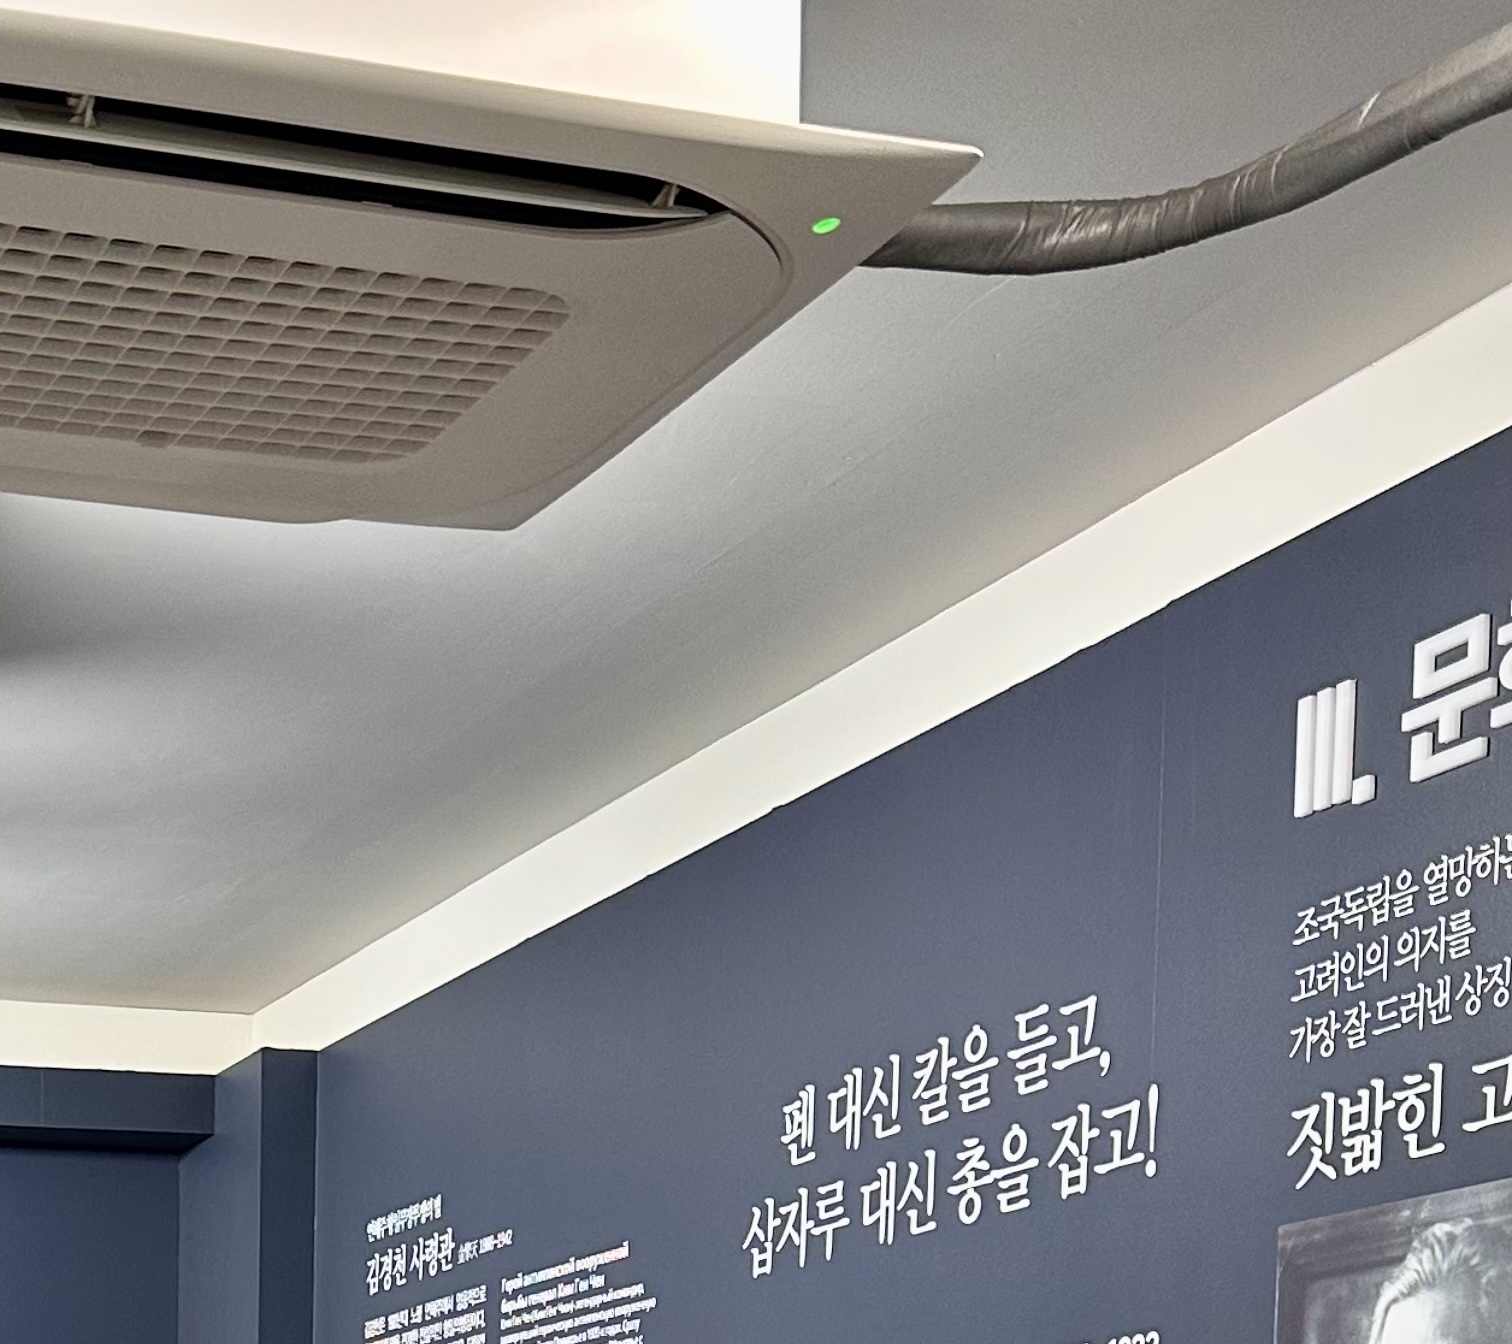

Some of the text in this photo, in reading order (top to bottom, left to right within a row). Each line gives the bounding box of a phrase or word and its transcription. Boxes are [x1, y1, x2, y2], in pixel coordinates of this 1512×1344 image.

[1292, 868, 1419, 946] 조국독립을
[1290, 909, 1476, 1002] 고려인의 의지를
[1289, 1010, 1341, 1064] 가장
[1342, 1000, 1371, 1050] 잘
[1372, 975, 1453, 1036] 드러낸
[781, 994, 1112, 1166] 펜 대신 칼을 들고,
[1287, 1062, 1446, 1190] 짓밟힌
[742, 1083, 1159, 1279] 삽자루 대신 총을 잡고!
[409, 1227, 456, 1280] 사령관
